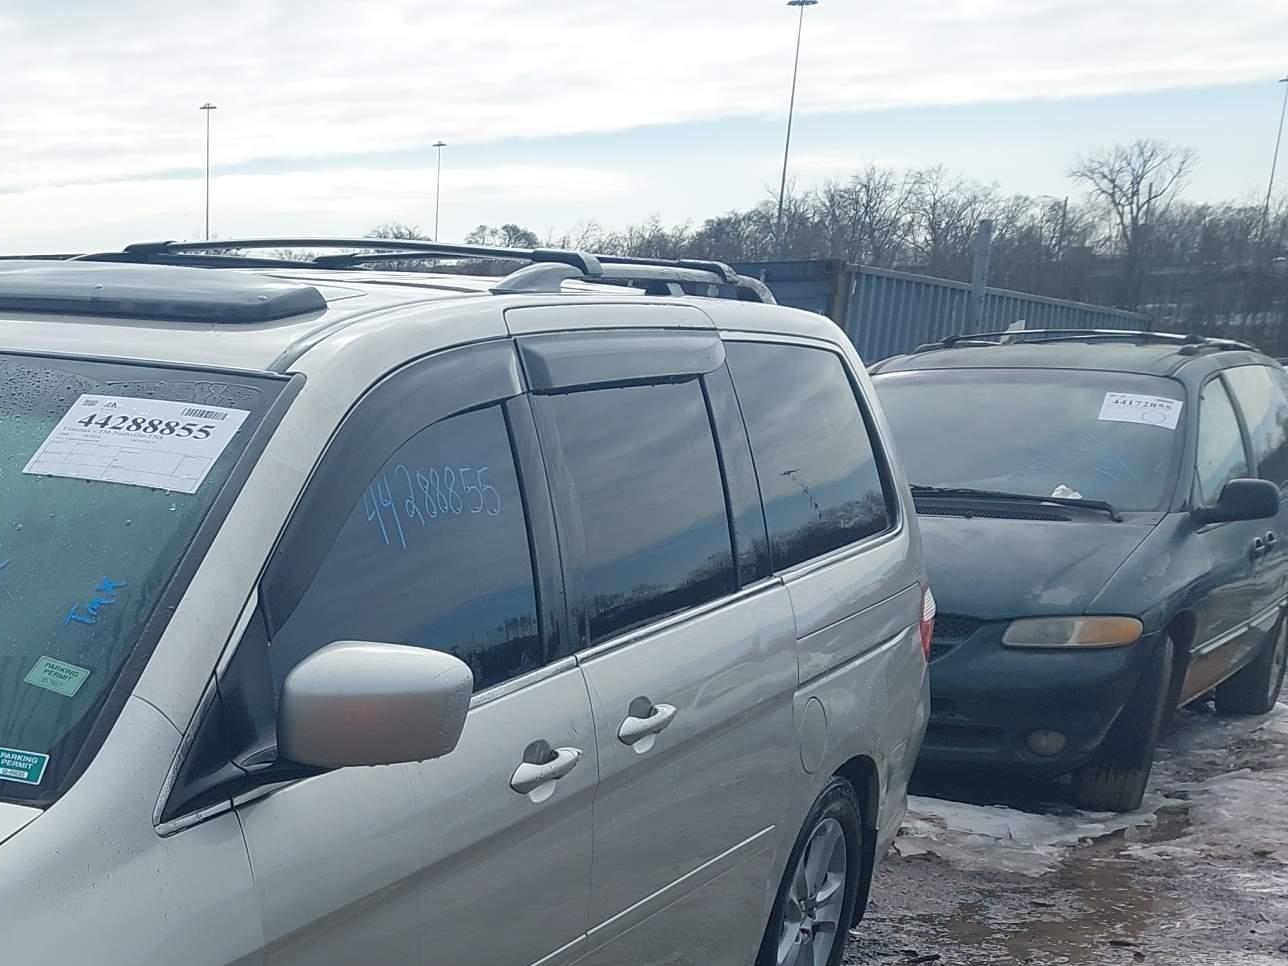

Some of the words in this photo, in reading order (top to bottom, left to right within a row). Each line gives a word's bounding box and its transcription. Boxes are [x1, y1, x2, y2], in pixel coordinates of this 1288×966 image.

[77, 412, 217, 440] 44288855
[363, 464, 501, 549] 44288855
[42, 668, 74, 681] PERMIT
[44, 662, 79, 677] PARKING
[0, 752, 39, 764] PARKING
[0, 759, 34, 770] PERMIT
